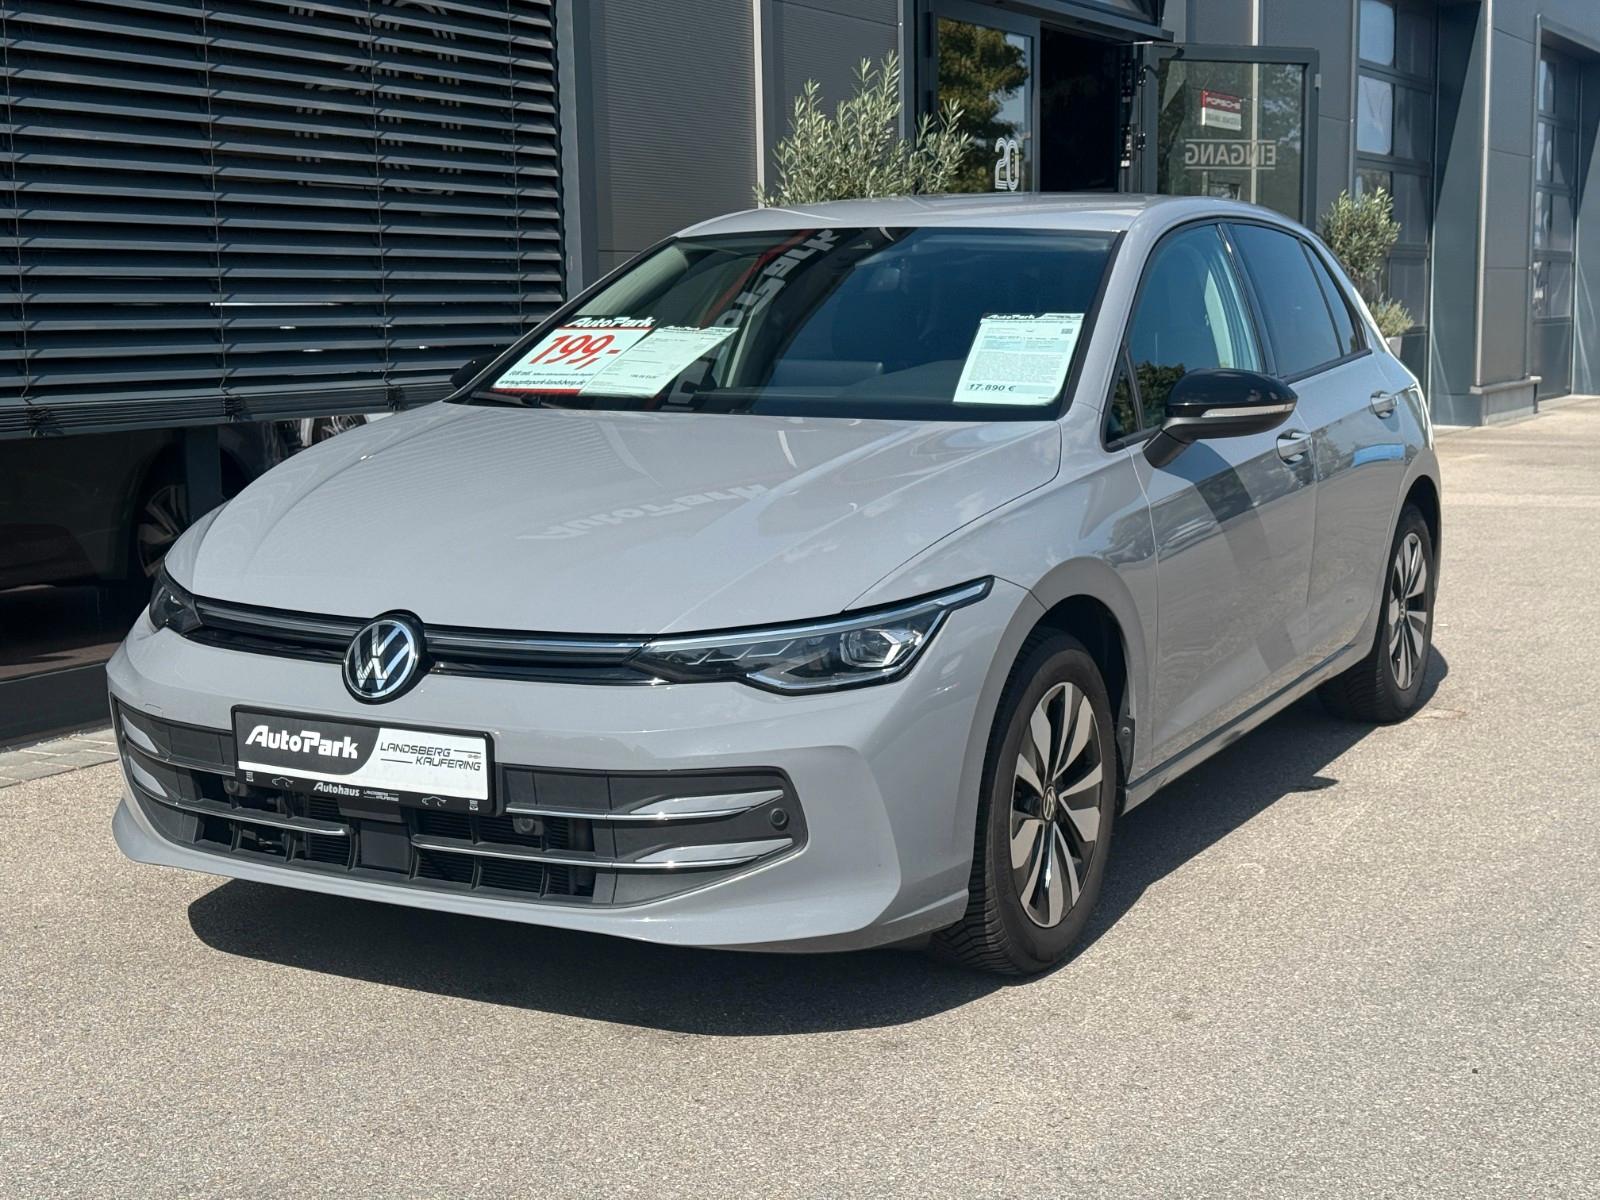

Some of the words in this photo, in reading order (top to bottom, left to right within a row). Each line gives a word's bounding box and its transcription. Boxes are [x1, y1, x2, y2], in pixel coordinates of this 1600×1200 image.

[994, 137, 1020, 192] 20
[564, 316, 656, 328] AutoPark
[968, 383, 1006, 392] 17.890
[245, 724, 359, 760] AutoPark
[379, 741, 452, 758] LANDSBERG
[415, 755, 482, 772] KAUFERING
[313, 781, 360, 797] Autohaus
